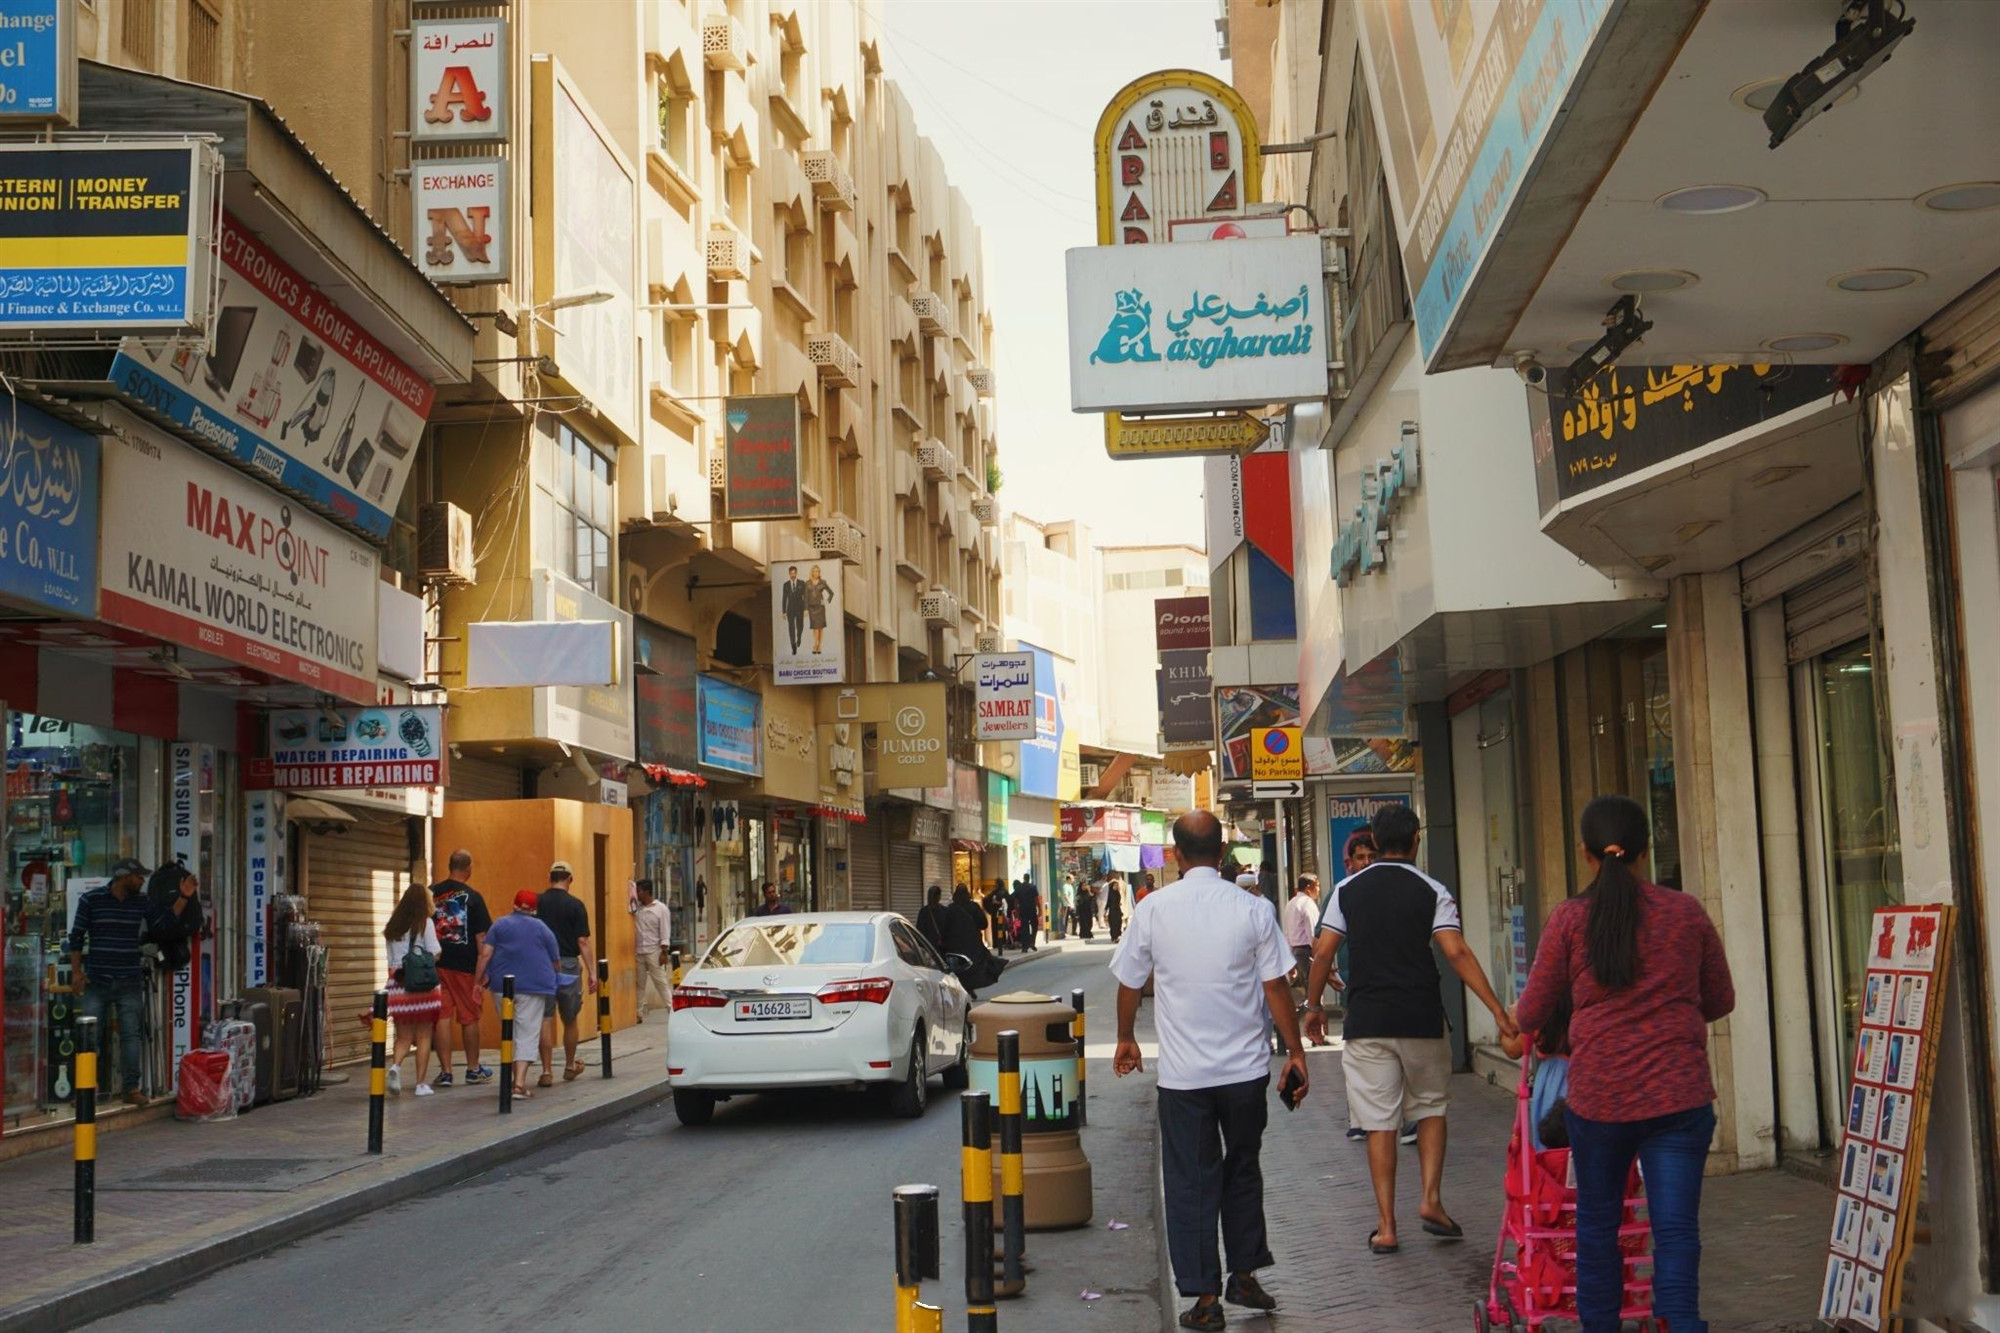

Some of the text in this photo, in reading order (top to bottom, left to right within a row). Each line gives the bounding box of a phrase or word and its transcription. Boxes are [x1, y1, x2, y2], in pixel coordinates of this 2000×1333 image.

[423, 32, 494, 53] للصرافة
[424, 66, 491, 124] A
[1146, 100, 1219, 131] فندق
[0, 179, 56, 193] TERN
[77, 178, 148, 193] MONEY
[423, 174, 494, 190] EXCHANGE
[0, 197, 55, 211] NION
[77, 195, 180, 210] TRANSFER
[426, 206, 491, 265] N
[1418, 186, 1443, 263] GOLDEN
[82, 274, 129, 297] الوطنية
[129, 272, 175, 297] الشركة
[8, 302, 54, 315] Finance
[57, 302, 69, 314] &
[72, 301, 131, 317] Exchange
[134, 301, 154, 314] Co.
[301, 295, 312, 318] &
[314, 305, 354, 350] HOME
[352, 339, 425, 406] APPLIANCES
[1166, 324, 1314, 369] asgharali
[126, 369, 178, 415] SONY
[189, 406, 239, 451] Panasonic
[255, 448, 285, 475] PHILIPS
[187, 481, 256, 556] MAX
[16, 520, 43, 570] Co.
[128, 551, 364, 672] KAMAL WORLD ELECTRONICS
[246, 643, 281, 664] ELECTRONICS
[779, 669, 793, 677] BABU
[812, 667, 837, 675] BOUTIQUE
[982, 660, 1026, 670] مجوهرات
[979, 699, 1031, 718] SAMRAT
[983, 720, 1029, 732] Jewellers
[275, 748, 407, 763] WATCH REPAIRING
[883, 738, 940, 754] JUMBO
[898, 755, 925, 765] GOLD
[274, 764, 434, 787] MOBILE REPAIRING
[1269, 768, 1301, 777] Parking
[175, 748, 190, 838] SAMSUNG
[1330, 798, 1403, 820] BexMo
[174, 967, 190, 1029] iPhone
[751, 1002, 792, 1016] 416628
